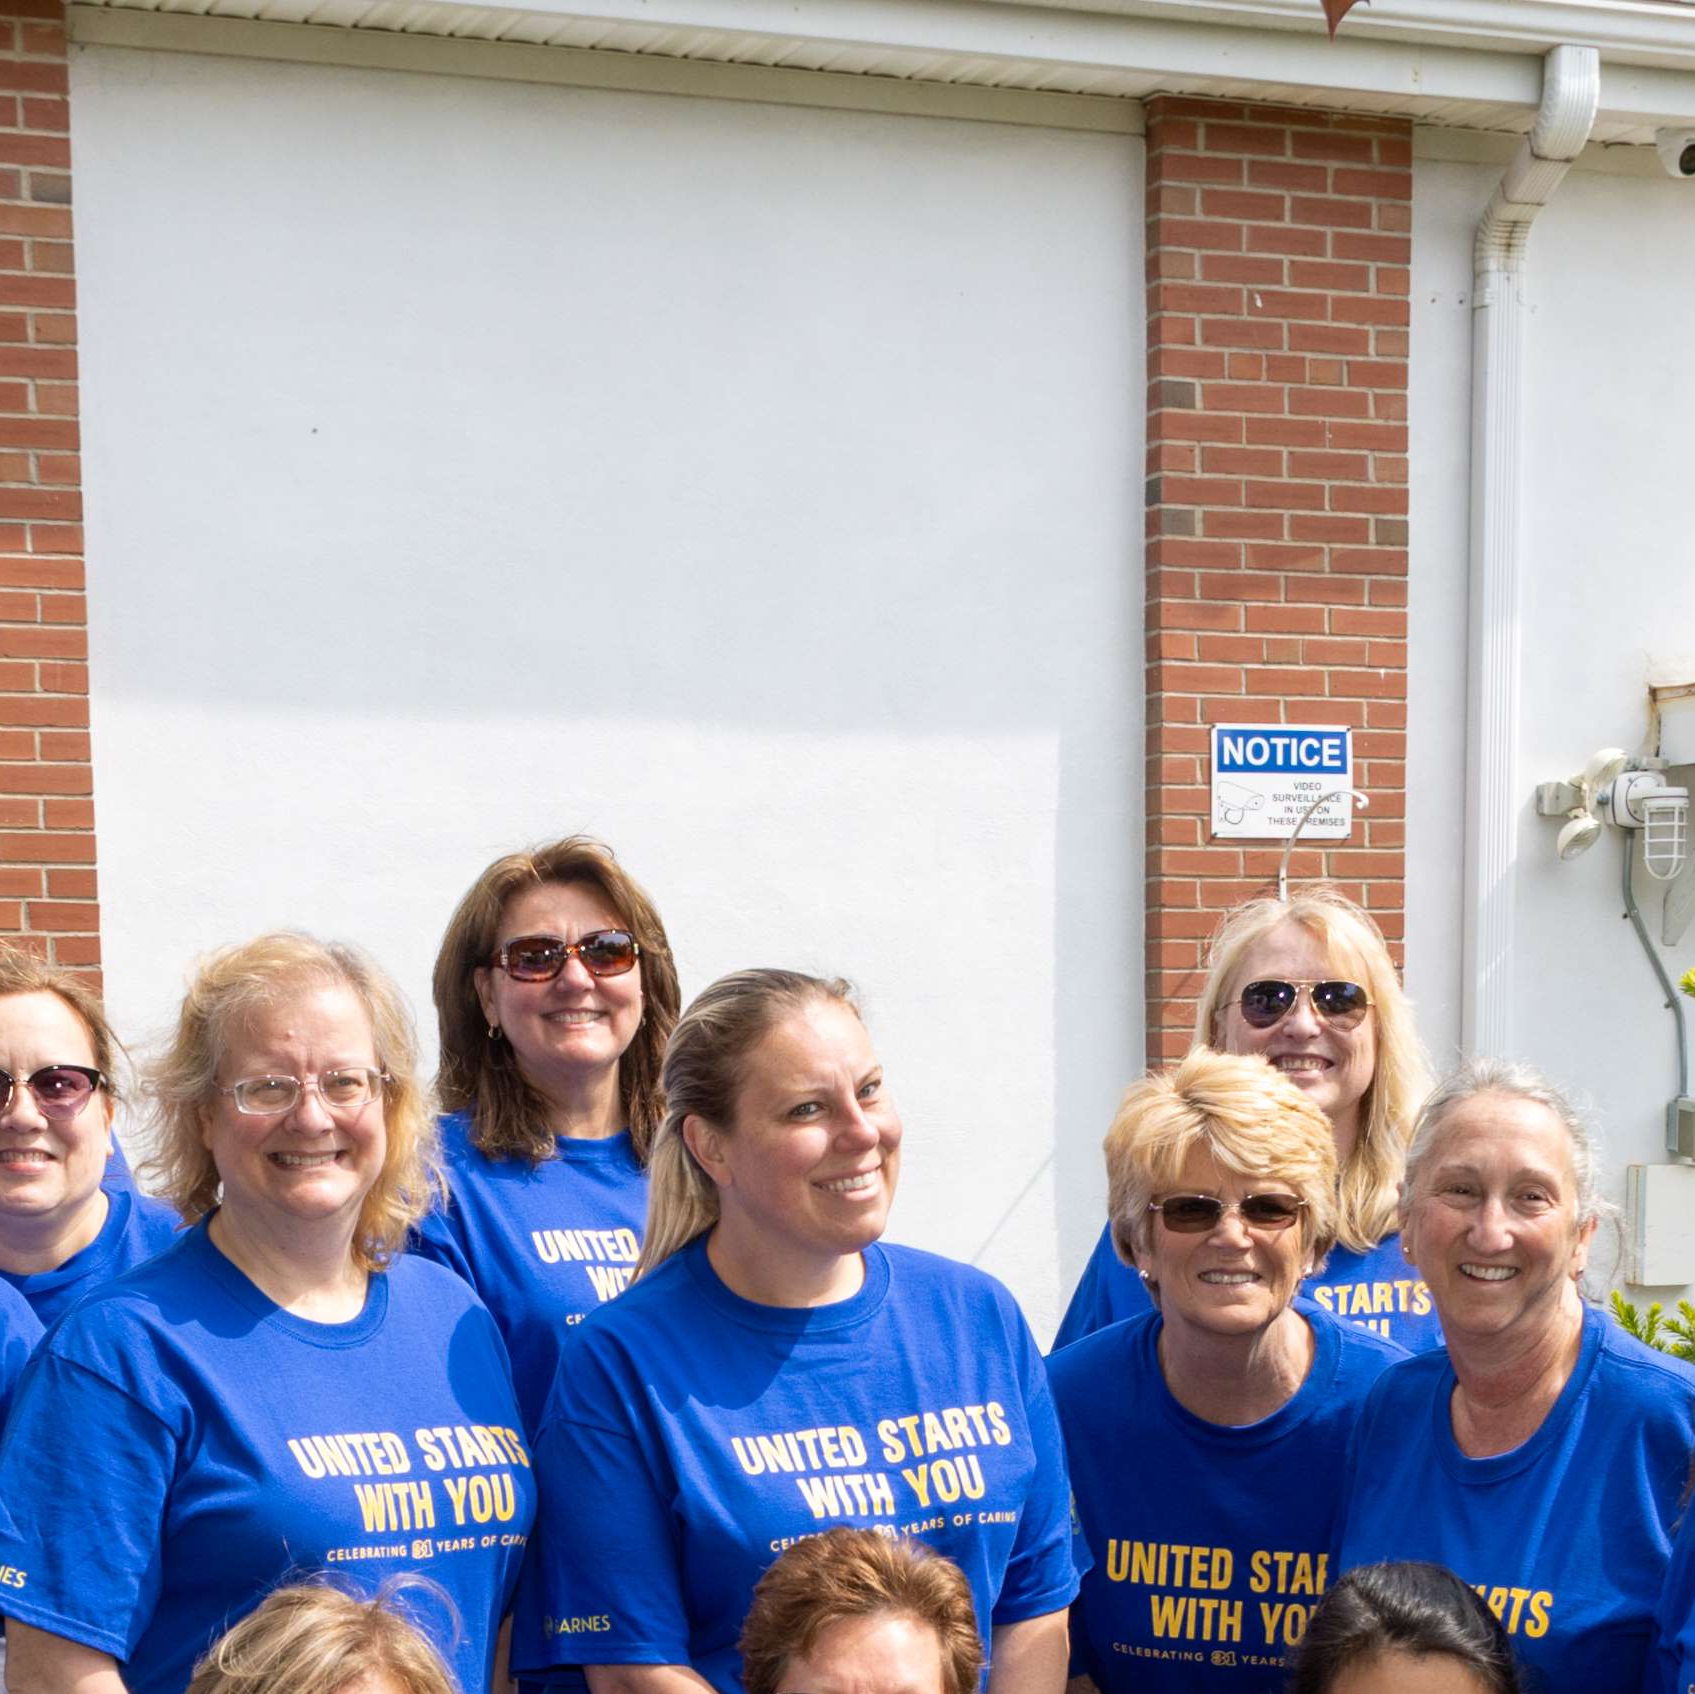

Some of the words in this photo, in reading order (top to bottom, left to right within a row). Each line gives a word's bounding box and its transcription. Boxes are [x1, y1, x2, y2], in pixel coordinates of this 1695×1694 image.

[1223, 736, 1342, 767] NOTICE
[1272, 794, 1342, 803] SURVEILLCE
[1293, 782, 1322, 791] VIDEO
[1268, 817, 1297, 826] THESE
[1306, 818, 1345, 826] REMISES
[1284, 806, 1293, 814] IN
[1296, 806, 1310, 814] US
[1317, 806, 1330, 815] ON
[531, 1228, 641, 1264] UNITED
[1314, 1280, 1431, 1315] STARTS
[287, 1432, 411, 1480] UNITED
[414, 1424, 530, 1471] STARTS
[731, 1425, 868, 1476] UNITED
[877, 1401, 1012, 1464] STARTS
[353, 1480, 436, 1532] WITH
[443, 1473, 515, 1525] YOU
[796, 1472, 896, 1520] WITH
[902, 1454, 986, 1508] YOU
[901, 1516, 945, 1537] YEARS
[953, 1513, 972, 1527] OF
[978, 1510, 1017, 1525] CARING
[326, 1544, 407, 1562] CELEBRATING
[436, 1538, 475, 1552] YEARS
[481, 1534, 497, 1548] OF
[1107, 1538, 1234, 1590] UNITED
[1250, 1550, 1330, 1596] STA
[554, 1614, 611, 1634] ARNES
[1150, 1594, 1244, 1642] WITH
[1259, 1601, 1316, 1647] YO
[1112, 1641, 1205, 1662] CELEBRATING
[1241, 1653, 1286, 1668] YEARS
